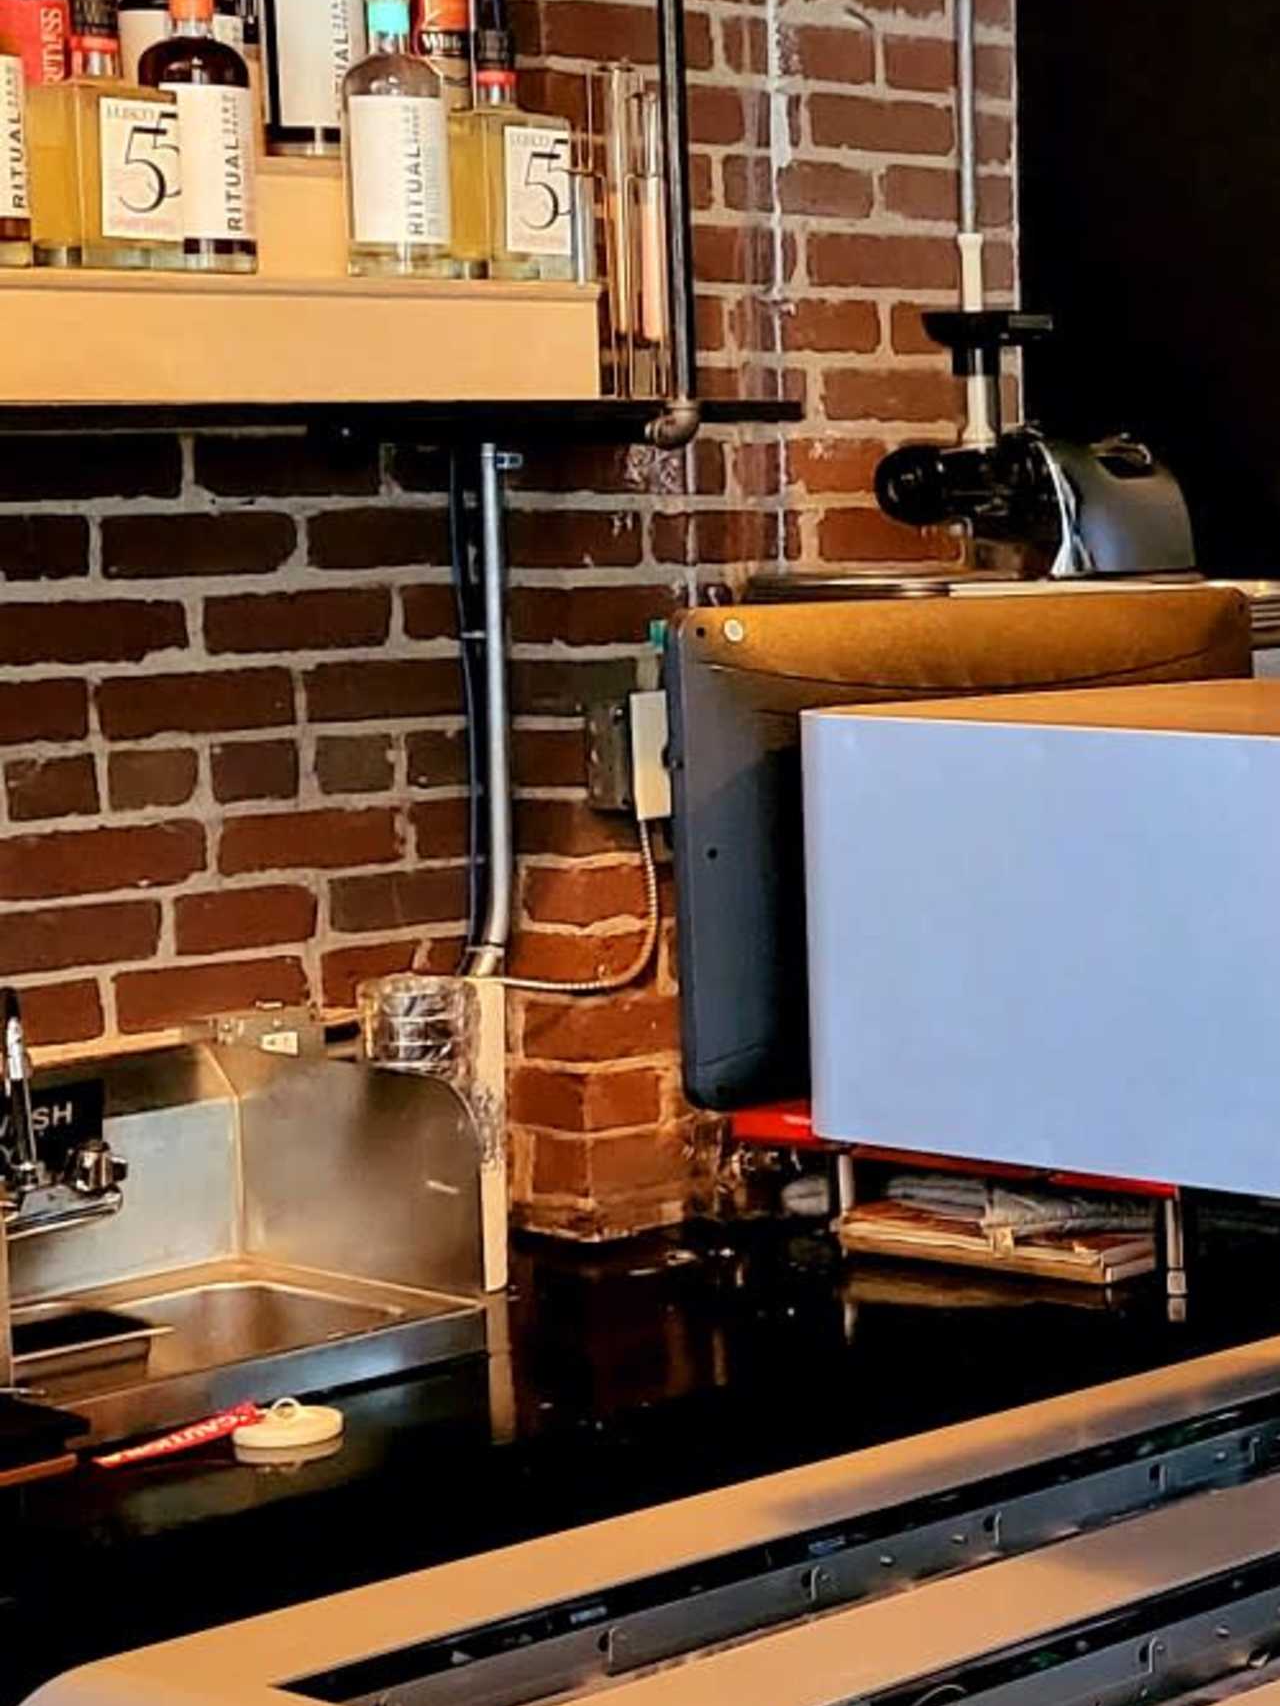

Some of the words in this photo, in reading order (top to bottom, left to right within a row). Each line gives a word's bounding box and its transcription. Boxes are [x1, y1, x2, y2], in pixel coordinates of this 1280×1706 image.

[7, 111, 25, 210] RITUAL
[224, 137, 242, 233] RITUAL
[403, 145, 424, 237] RITUAL
